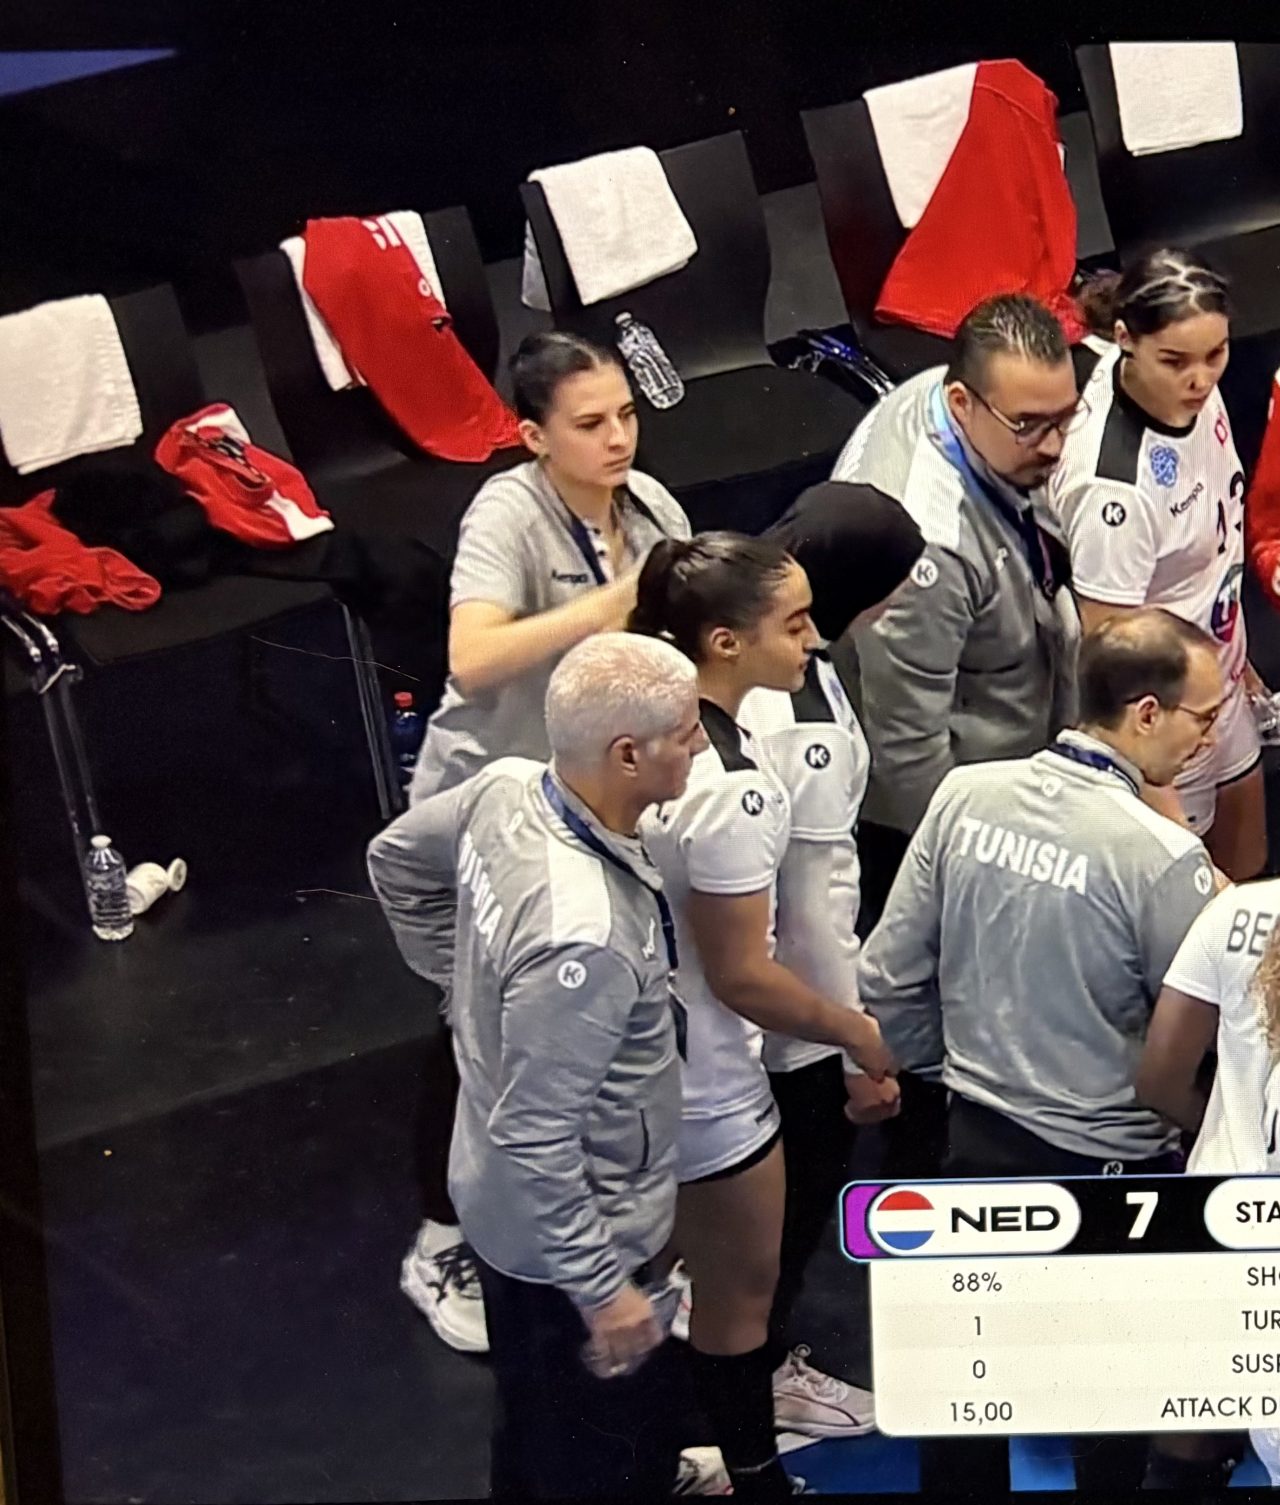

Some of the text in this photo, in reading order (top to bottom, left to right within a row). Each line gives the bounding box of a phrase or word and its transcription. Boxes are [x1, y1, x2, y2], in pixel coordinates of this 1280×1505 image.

[957, 817, 1090, 895] TUNISIA
[951, 1205, 1061, 1234] NED
[1125, 1191, 1159, 1239] 7
[951, 1271, 1003, 1293] 88%
[974, 1315, 982, 1336] 1
[971, 1358, 986, 1379] 0
[950, 1401, 1013, 1425] 15,00
[1160, 1396, 1253, 1419] ATTACK
